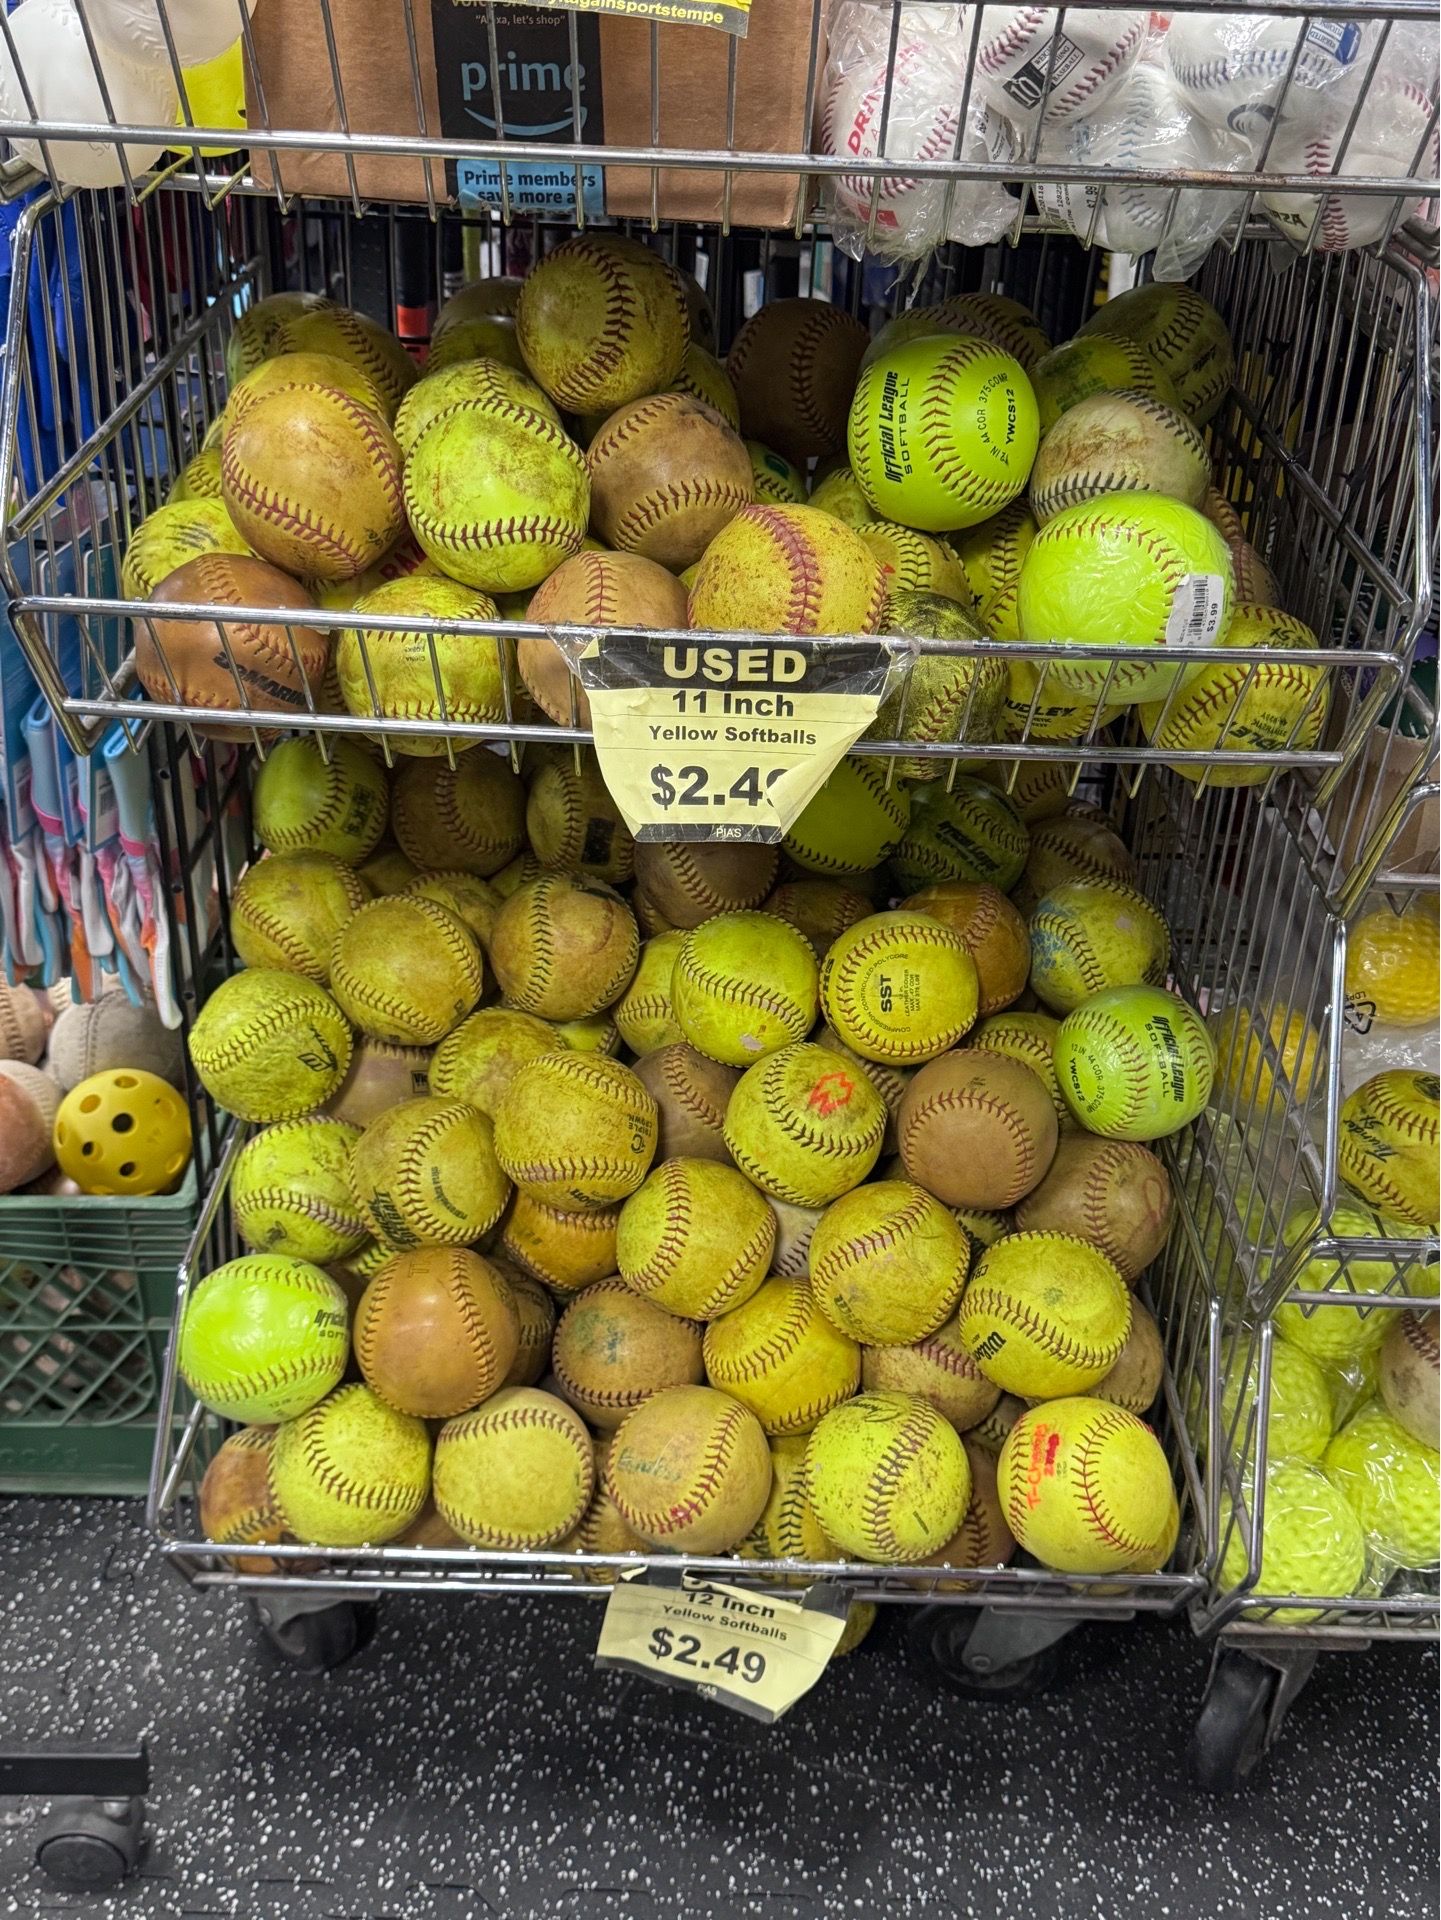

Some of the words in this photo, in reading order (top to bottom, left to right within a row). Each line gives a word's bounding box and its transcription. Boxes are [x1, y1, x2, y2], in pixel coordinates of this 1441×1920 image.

[476, 15, 510, 26] "Axa,
[1009, 76, 1042, 107] 10
[519, 191, 562, 204] more
[879, 370, 900, 422] League
[898, 378, 913, 475] SOFTBALL
[977, 409, 987, 431] COR
[1005, 388, 1017, 445] YWCS12
[879, 424, 903, 484] Official
[1207, 603, 1219, 632] $3.99
[663, 646, 807, 683] USED
[672, 690, 708, 713] 11
[723, 692, 795, 717] Inch
[649, 724, 718, 742] Yellow
[724, 726, 817, 745] Softballs
[715, 826, 742, 839] PIAS
[860, 967, 875, 1011] CONTROLLED
[873, 953, 910, 968] POLYCORE
[879, 974, 893, 1013] SST
[1092, 1063, 1104, 1081] COR
[1144, 1022, 1170, 1098] SOFTBALL
[1152, 1015, 1183, 1060] Official
[1170, 1062, 1185, 1102] League
[1069, 1057, 1086, 1102] YWCS12
[628, 1122, 652, 1137] TRIPLE
[1343, 1118, 1398, 1163] Thunder
[685, 1591, 714, 1606] 12
[663, 1605, 715, 1623] Yellow
[719, 1616, 788, 1642] Softballs
[648, 1627, 766, 1684] $2.49
